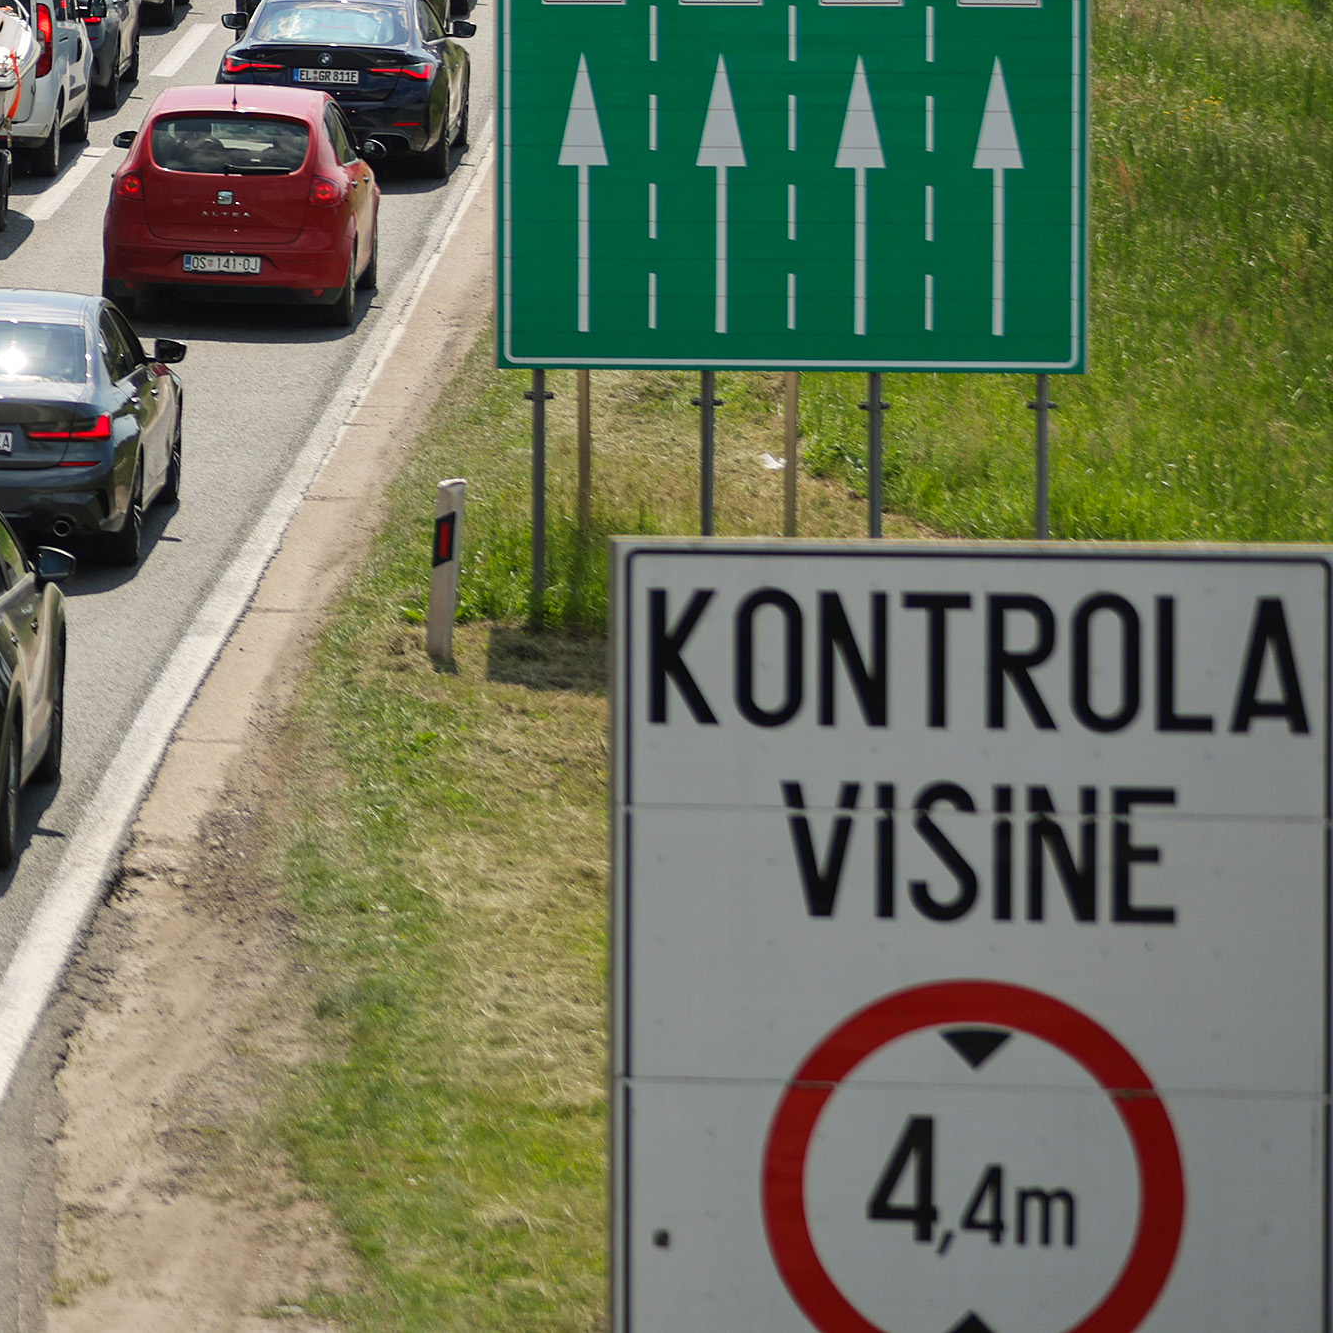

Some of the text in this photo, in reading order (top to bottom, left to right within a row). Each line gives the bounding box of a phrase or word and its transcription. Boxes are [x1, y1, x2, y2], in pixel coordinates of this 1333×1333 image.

[299, 69, 357, 82] EL GR 811E
[201, 210, 251, 218] ALTEA
[646, 586, 1311, 734] KONTROLA
[779, 780, 1178, 924] VISINE
[866, 1113, 1077, 1254] 4,4m
